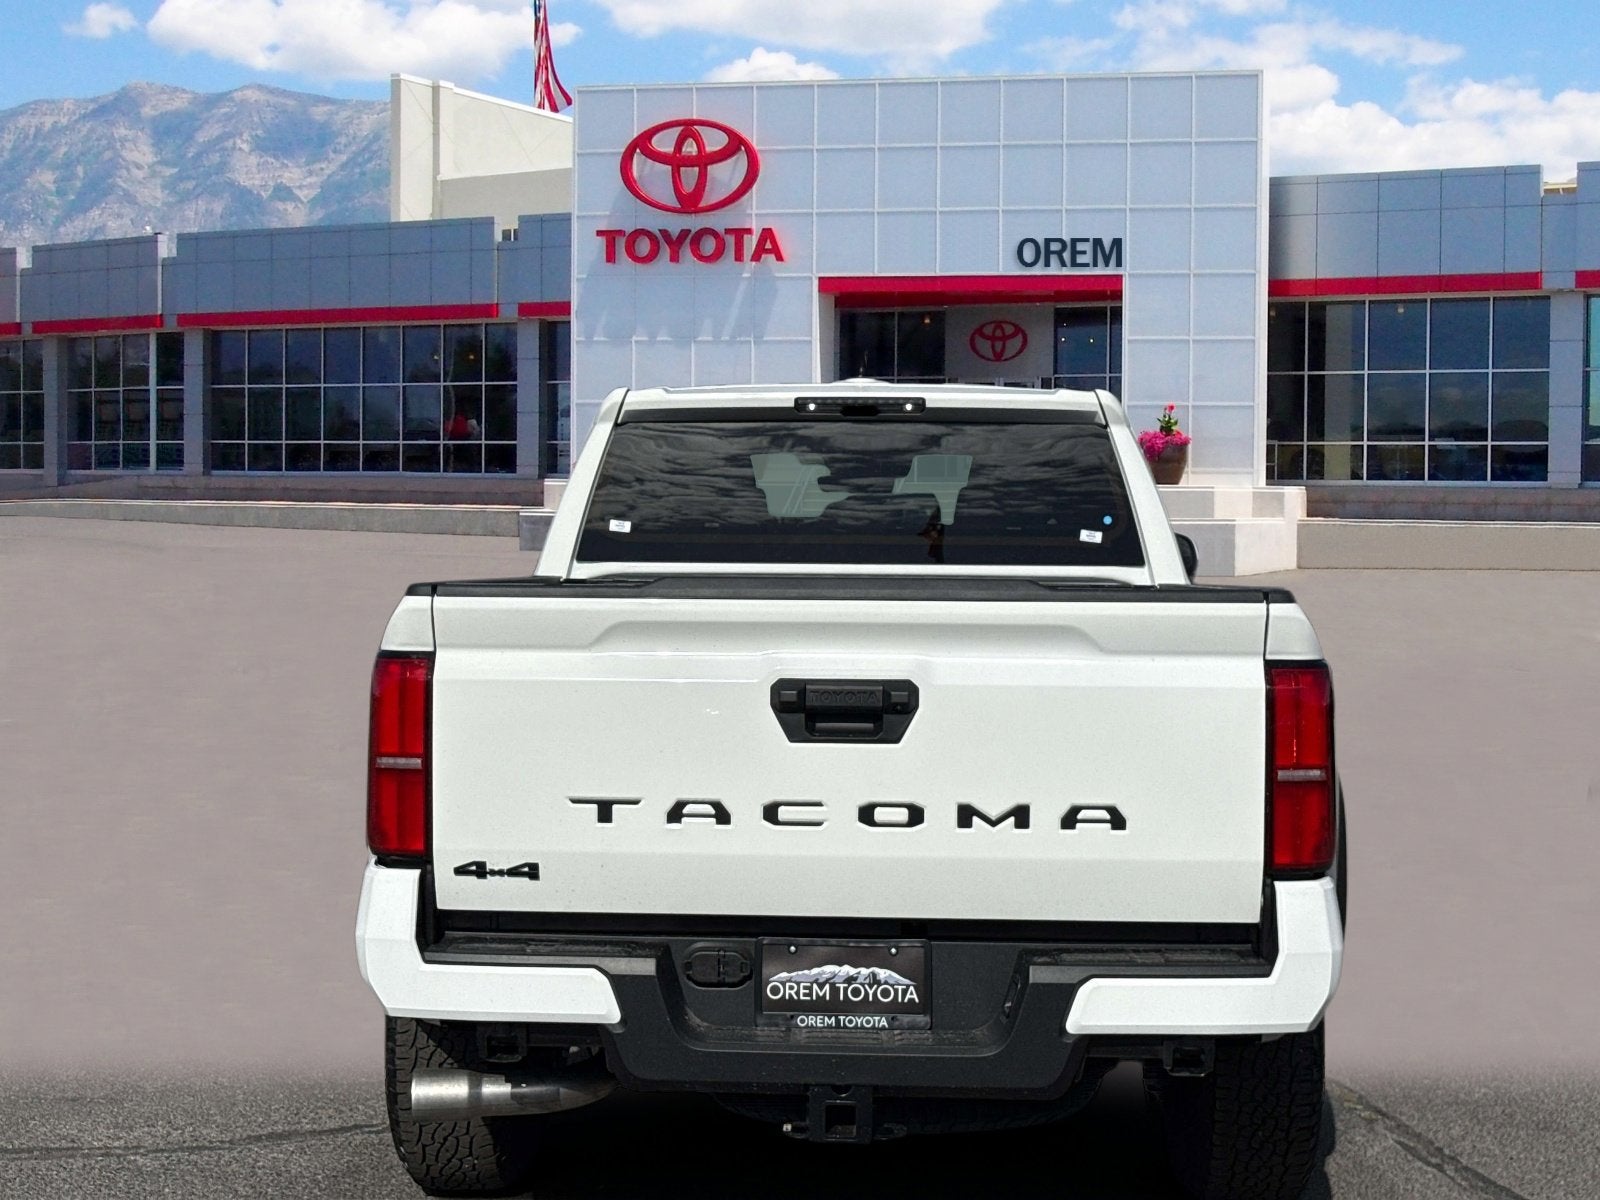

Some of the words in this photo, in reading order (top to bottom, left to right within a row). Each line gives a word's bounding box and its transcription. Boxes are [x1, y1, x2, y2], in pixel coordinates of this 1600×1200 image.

[596, 227, 785, 264] TOYOTA
[1017, 237, 1123, 268] OREM
[810, 690, 879, 704] TOYOTA
[567, 796, 1128, 832] TACOMA
[766, 982, 830, 1001] OREM
[835, 983, 920, 1004] TOYOTA
[797, 1015, 836, 1027] OREM
[838, 1016, 889, 1028] TOYOTA
